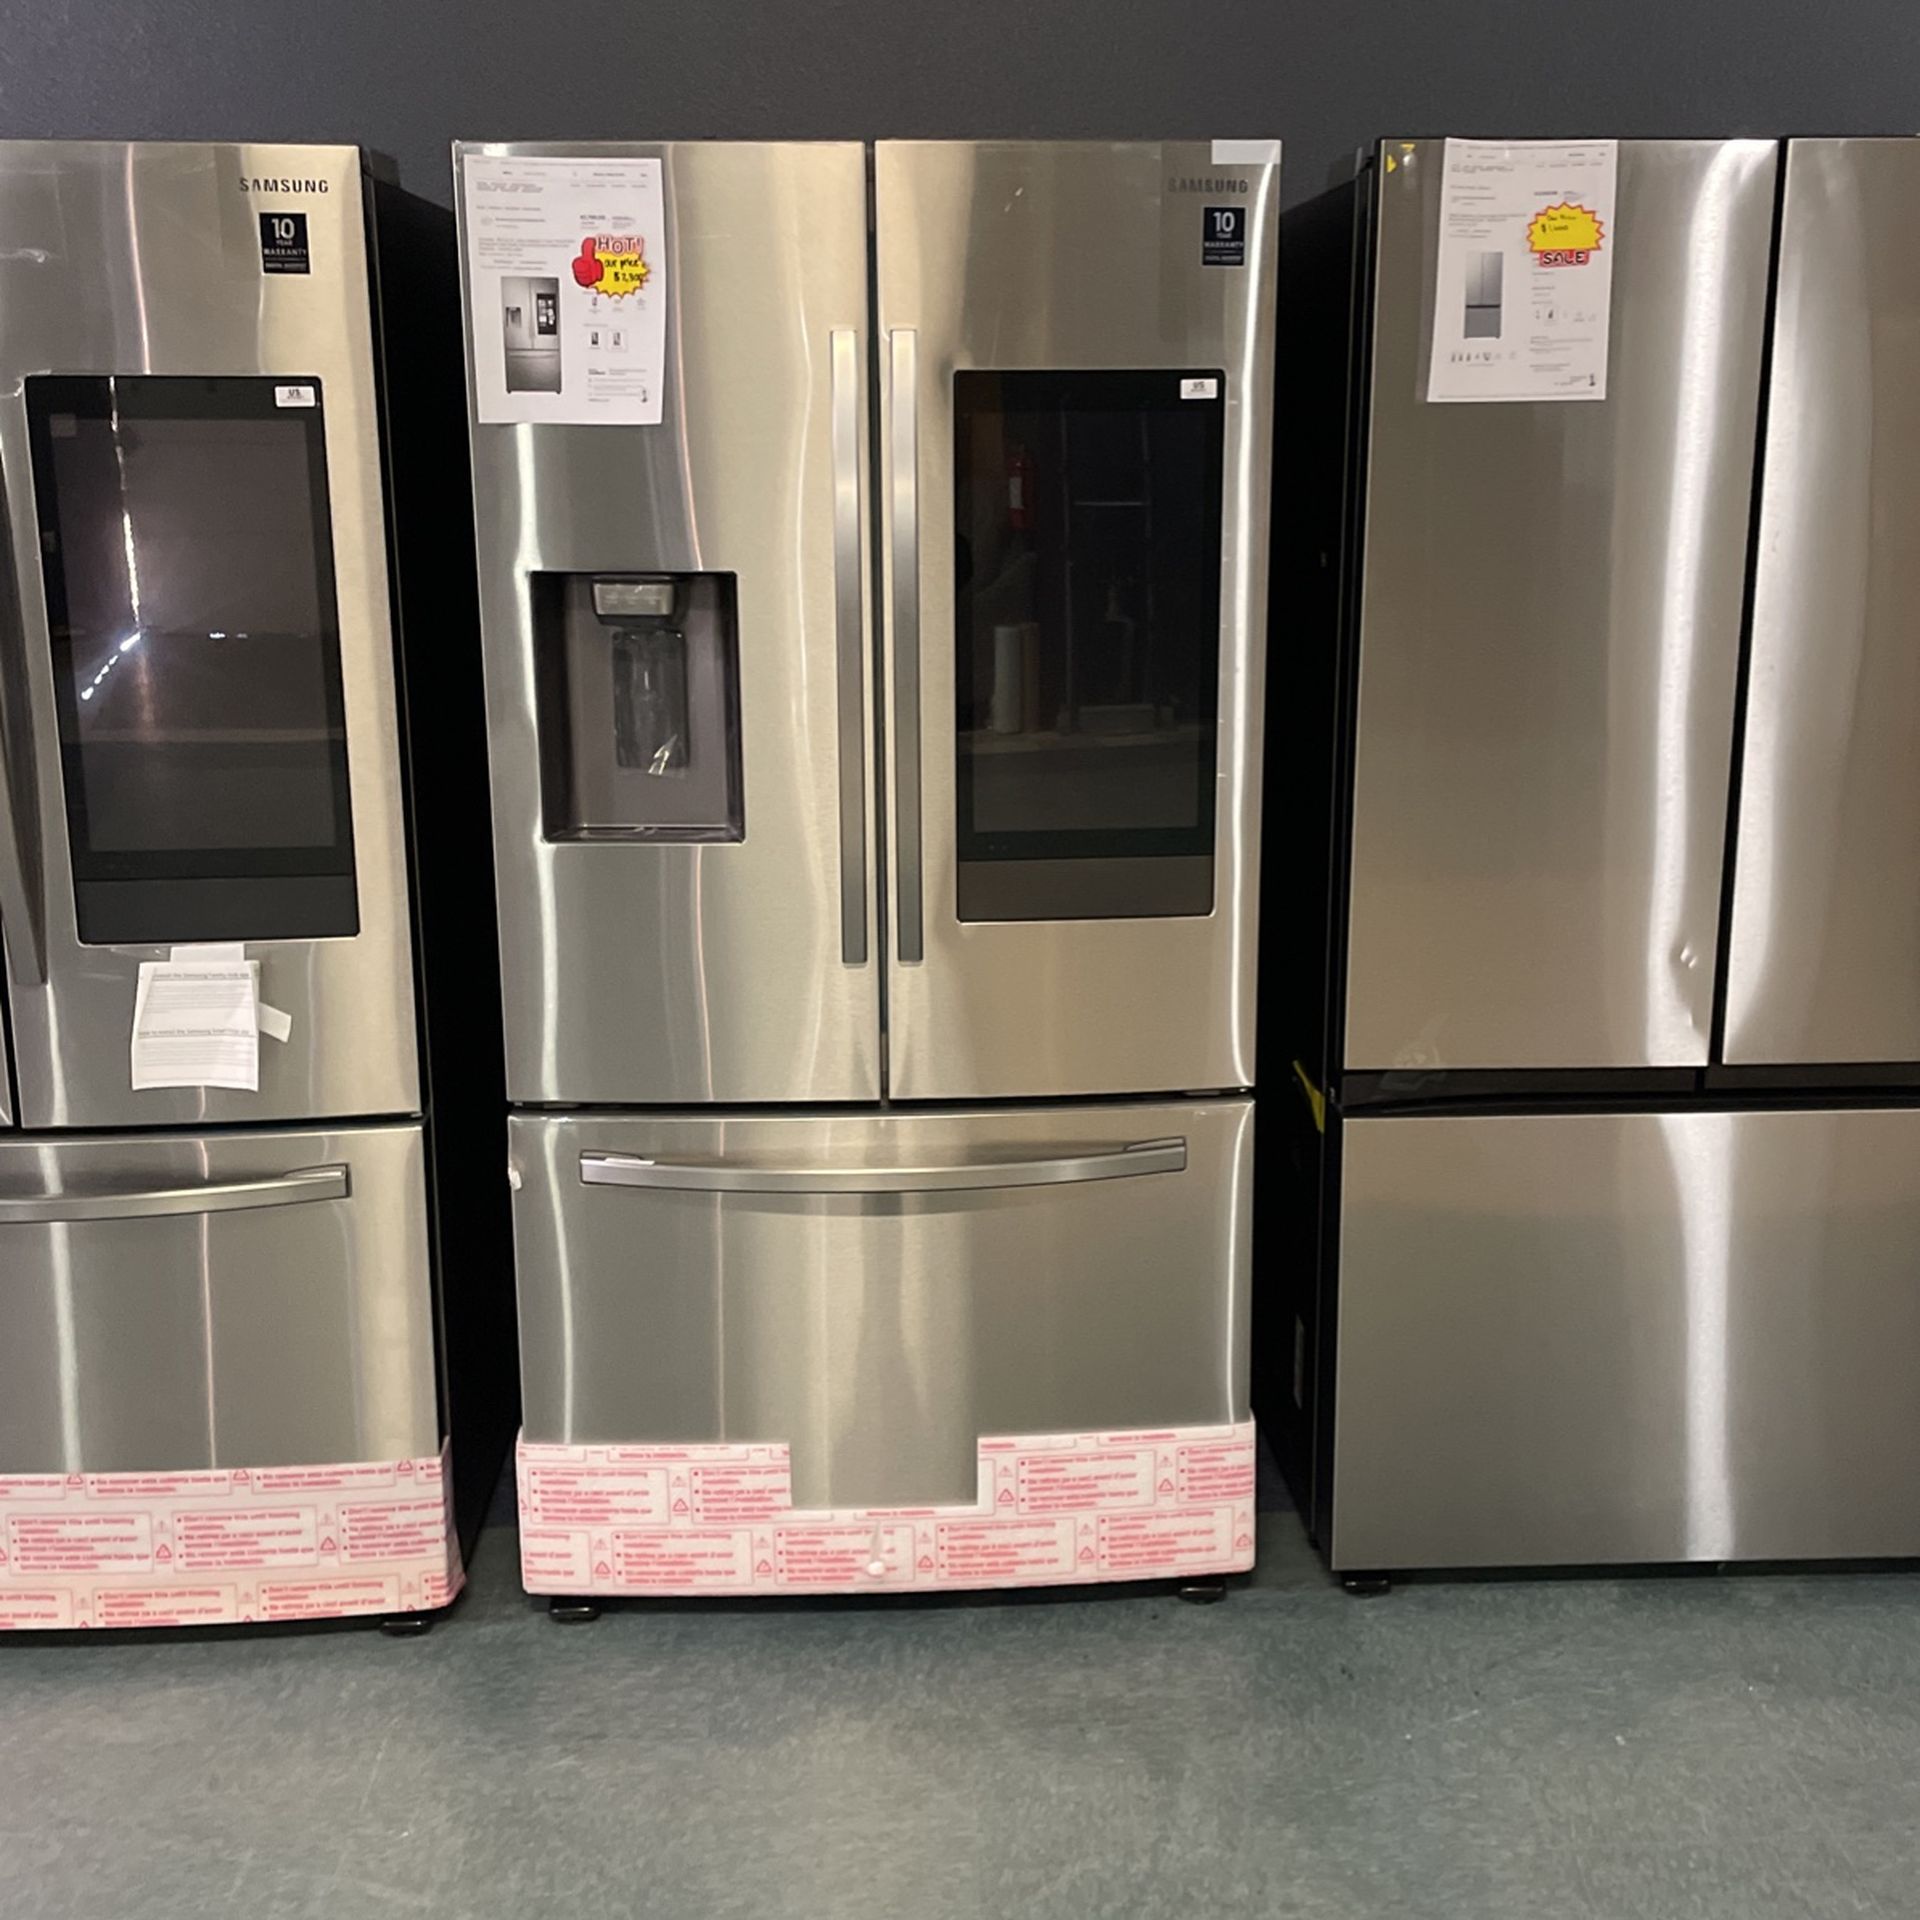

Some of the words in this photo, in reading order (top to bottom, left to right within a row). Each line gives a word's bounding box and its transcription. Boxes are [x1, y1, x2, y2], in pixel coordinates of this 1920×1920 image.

[240, 177, 330, 193] SAMSUNG
[1167, 178, 1249, 193] SAMSUNG
[271, 217, 295, 240] 10
[1213, 211, 1235, 232] 10
[263, 247, 307, 256] WARRANTY
[1543, 251, 1586, 265] SALE
